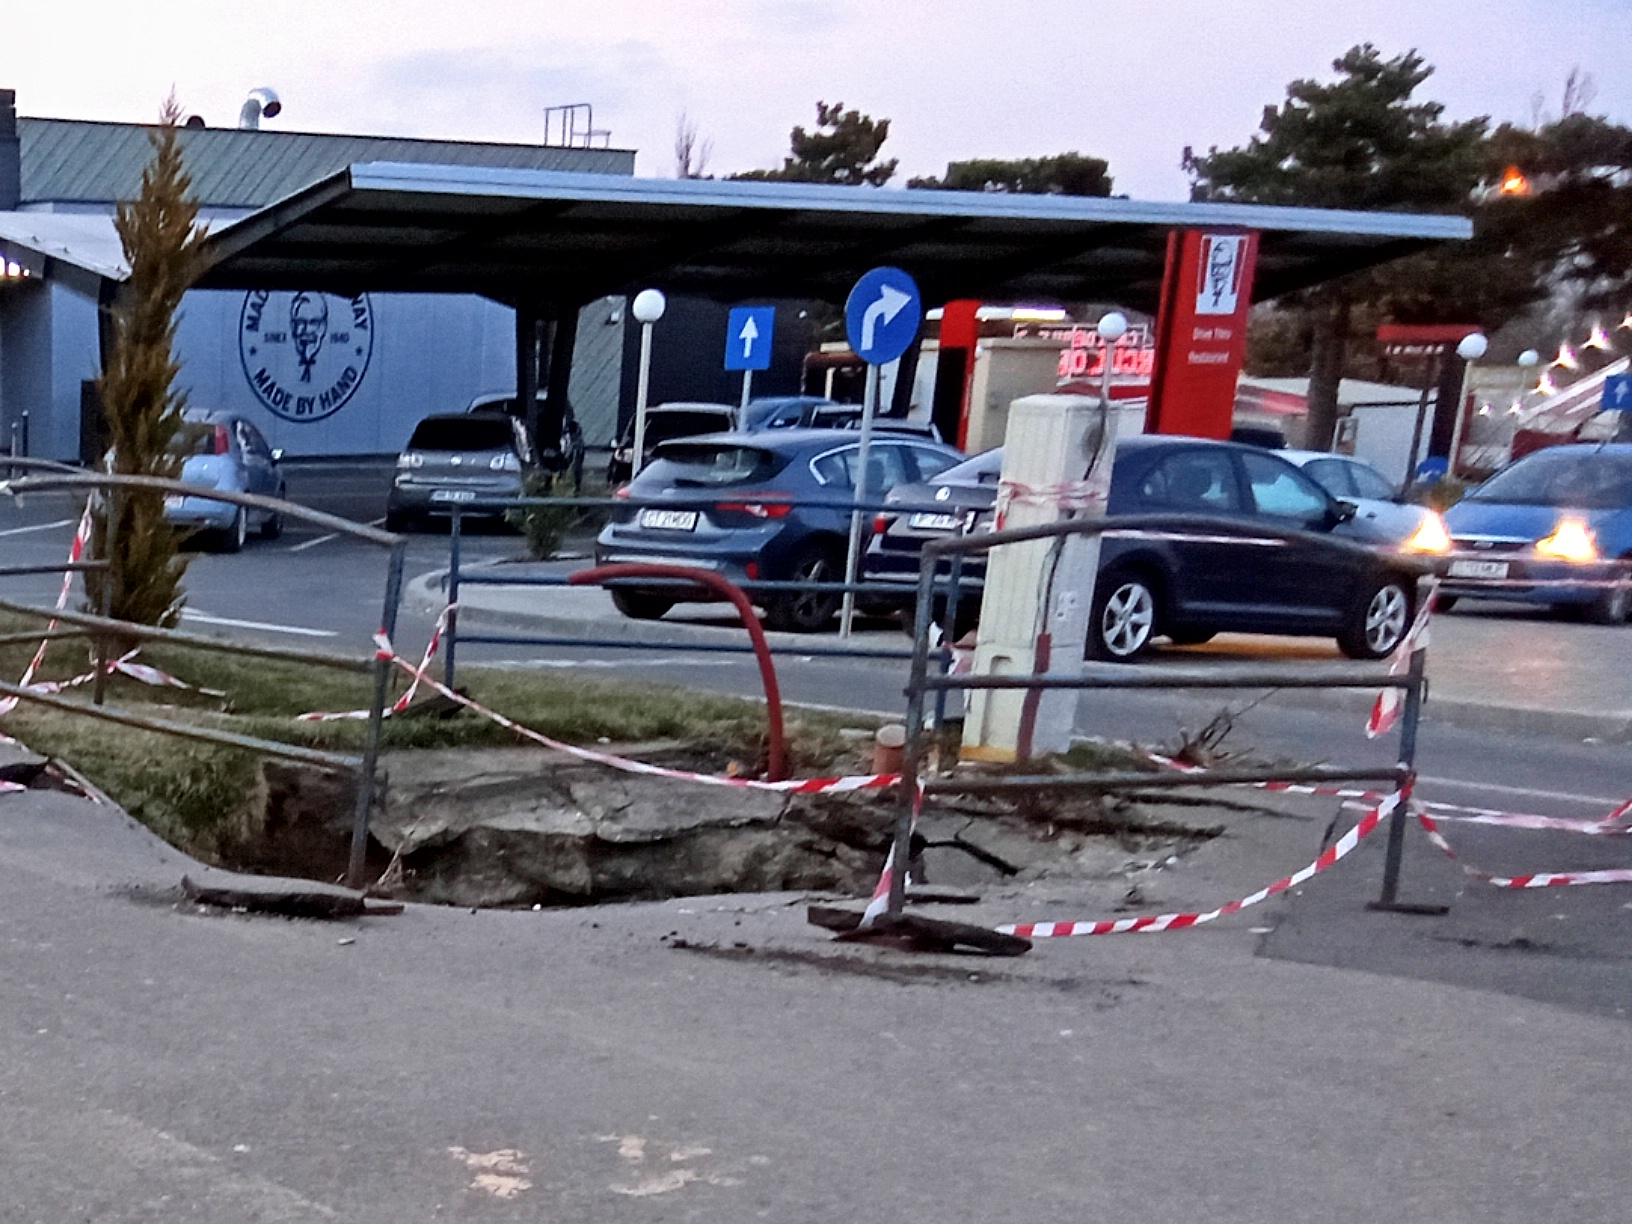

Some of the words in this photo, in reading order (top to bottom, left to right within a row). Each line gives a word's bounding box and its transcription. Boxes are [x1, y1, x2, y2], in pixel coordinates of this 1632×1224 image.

[253, 366, 293, 413] MADE
[295, 396, 316, 416] BY
[318, 365, 360, 412] HAND
